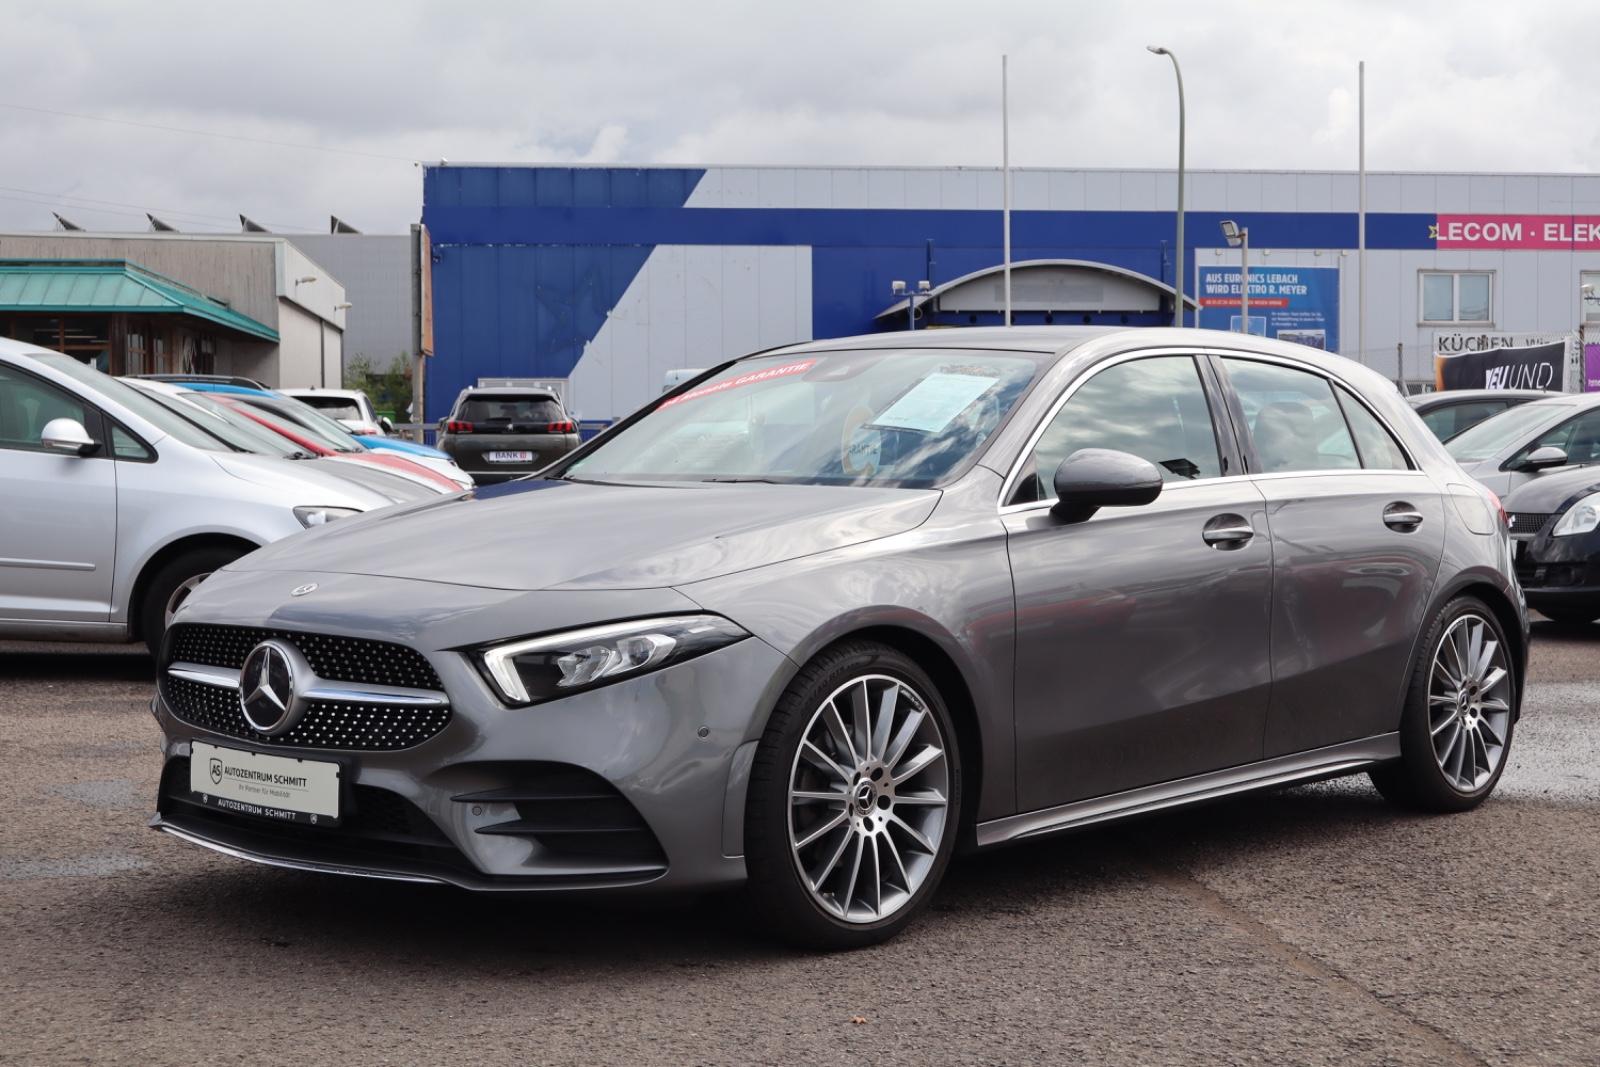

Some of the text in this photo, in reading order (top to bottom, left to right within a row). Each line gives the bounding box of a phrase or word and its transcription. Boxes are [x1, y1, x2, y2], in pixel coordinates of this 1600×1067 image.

[1206, 274, 1298, 284] AUS EURNICS LEBACH
[1206, 285, 1307, 295] WIRD ELKTRO R. MEYER
[212, 764, 221, 777] AS
[224, 766, 307, 787] AUTOZENTRUM SCHMITT
[218, 799, 297, 820] AUTOZENTRUM SCHMITT
